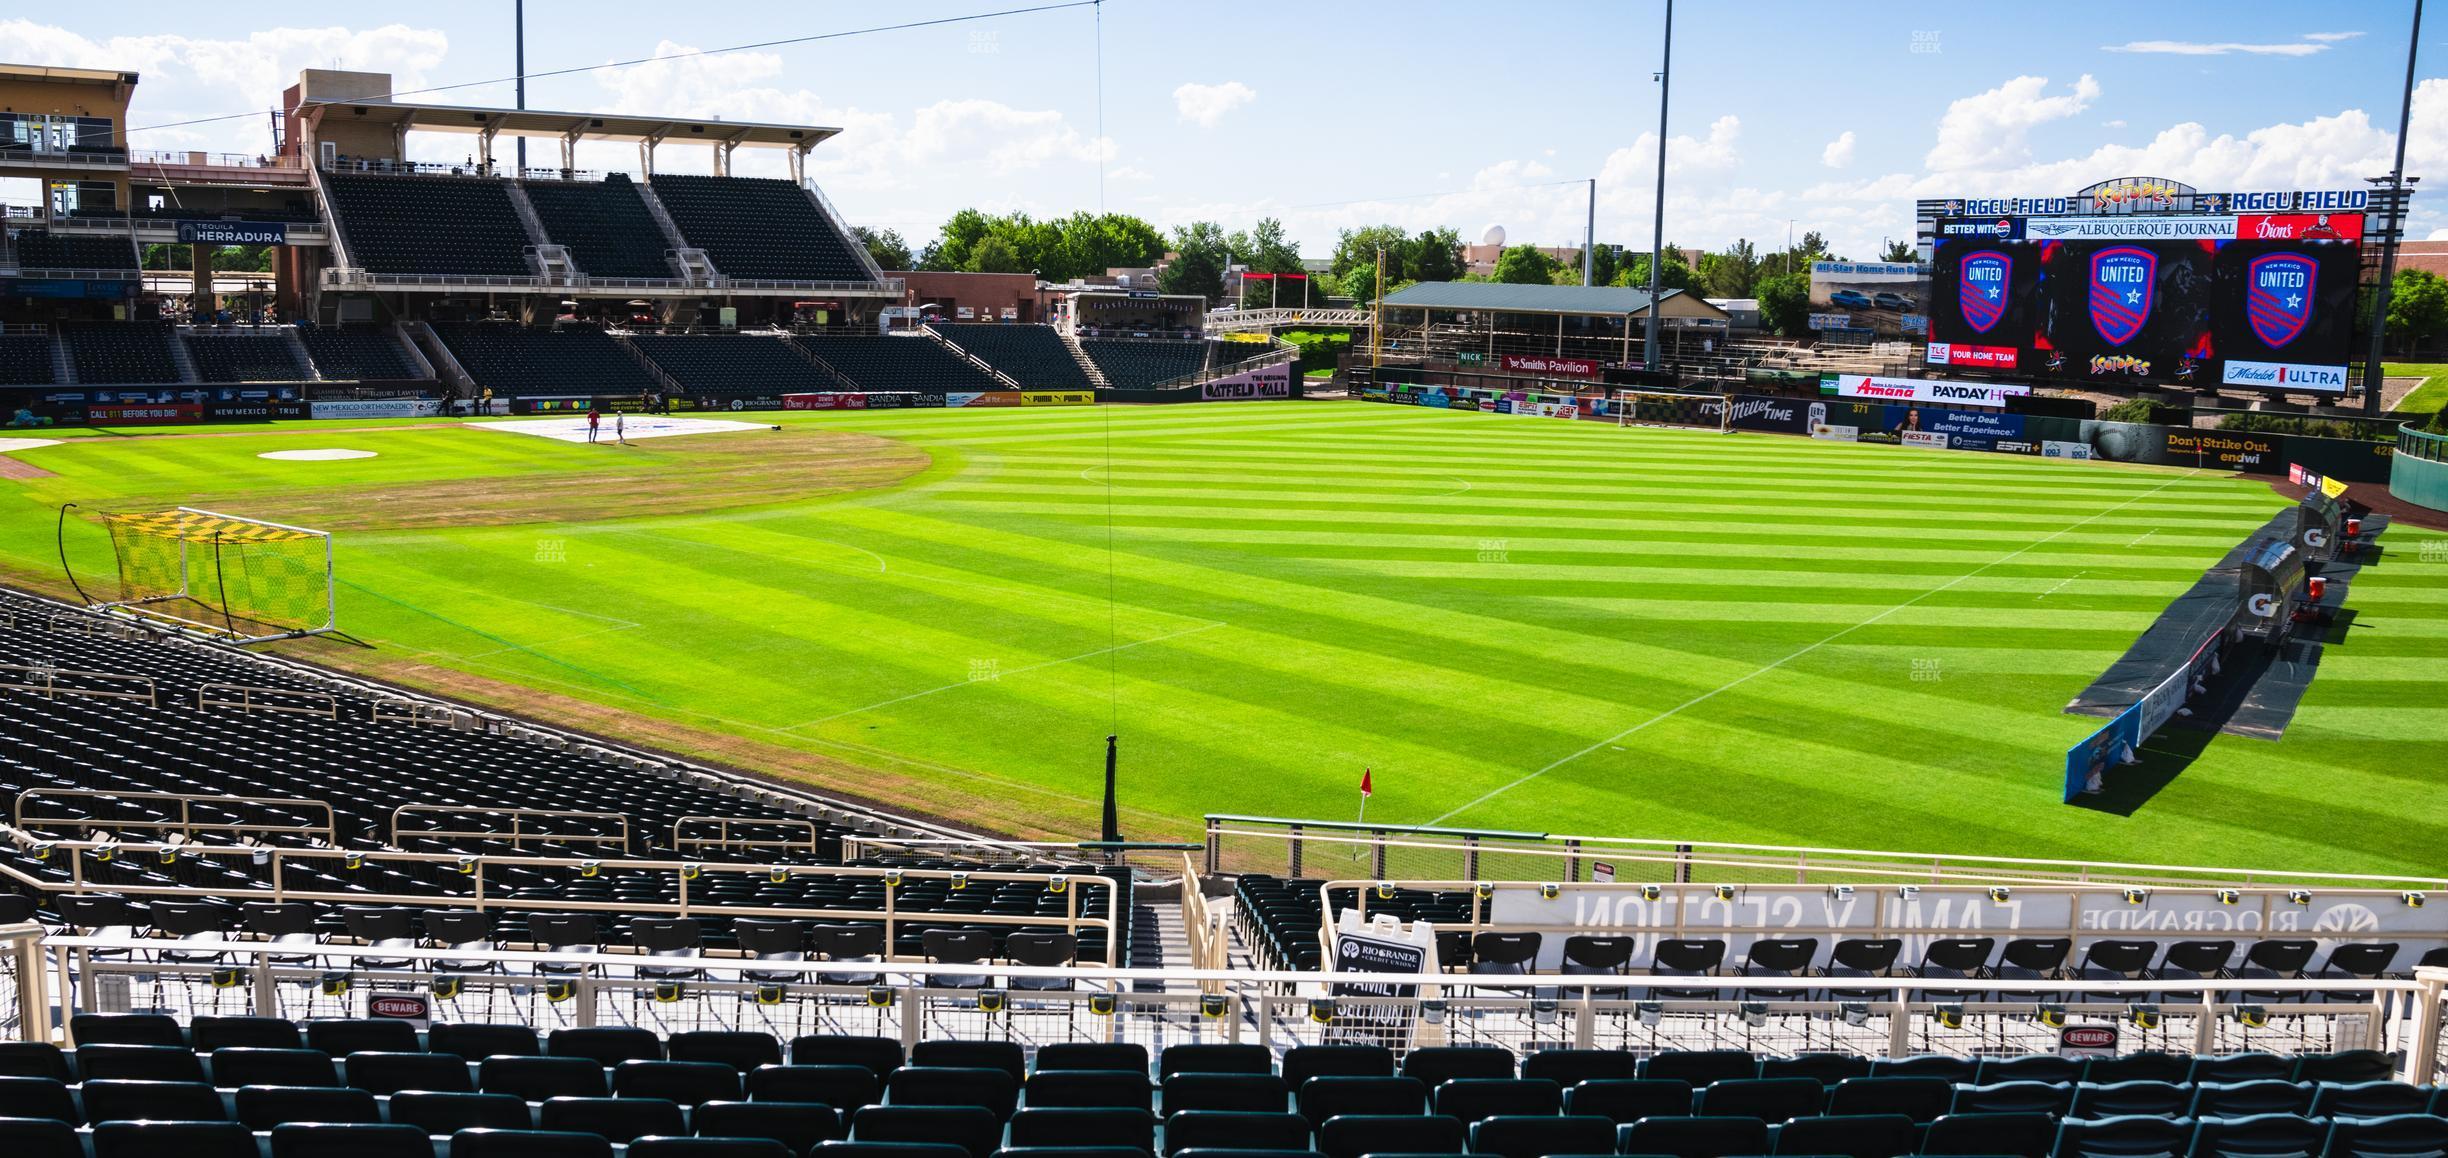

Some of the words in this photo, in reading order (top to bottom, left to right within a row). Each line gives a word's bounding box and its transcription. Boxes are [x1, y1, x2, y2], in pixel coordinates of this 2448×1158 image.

[1966, 199, 2010, 214] RGCU
[2018, 198, 2067, 214] FIELD
[2232, 191, 2292, 210] RGCU
[2302, 190, 2367, 209] FIELD
[1944, 224, 1975, 234] BETTER
[1977, 225, 1998, 234] WITH
[2079, 223, 2173, 237] ALBUQUERQUE
[2173, 223, 2235, 237] JOURNAL
[2256, 216, 2293, 238] Dion's
[197, 231, 283, 242] HERRADURA
[1856, 264, 1885, 274] Home
[1886, 265, 1905, 274] Run
[1969, 267, 2002, 281] UNITED
[2101, 266, 2144, 282] UNITED
[2260, 271, 2304, 287] UNITED
[1932, 346, 1945, 354] TLC
[1953, 350, 1971, 359] YOUR
[1973, 352, 1992, 360] HOME
[1995, 353, 2014, 361] TEAM
[1460, 353, 1481, 361] NICK
[1520, 358, 1547, 370] Smith's
[1549, 360, 1588, 373] Pavilion
[2227, 366, 2277, 381] Michelob
[2289, 370, 2340, 385] ULTRA
[1257, 382, 1287, 396] WALL
[1856, 378, 1915, 397] Amana
[1933, 385, 1989, 400] PAYDAY
[868, 394, 901, 402] SANDIA
[912, 394, 944, 402] SANDIA
[91, 410, 108, 419] CALL
[122, 409, 149, 418] BEFORE
[150, 409, 163, 417] YOU
[164, 408, 177, 416] DIG!
[215, 408, 234, 416] NEW
[279, 407, 300, 415] TRUE
[1700, 403, 1722, 415] IT'S
[1722, 400, 1774, 421] Miller
[1764, 408, 1793, 421] TIME
[1811, 405, 1825, 418] Lite
[1852, 403, 1868, 414] 371
[1948, 413, 1975, 423] Better
[1977, 415, 2000, 425] Deal.
[1934, 423, 1960, 432] Better
[1903, 432, 1931, 441] FIESTA
[2168, 434, 2201, 447] Don't
[2203, 437, 2241, 450] Strike
[2243, 440, 2271, 453] Out.
[2373, 445, 2393, 456] 428
[2219, 452, 2260, 464] endwi
[1365, 955, 1389, 966] CREDIT
[1390, 959, 1413, 968] UNION
[378, 1002, 419, 1013] BEWARE
[2070, 1032, 2109, 1042] BEWARE
